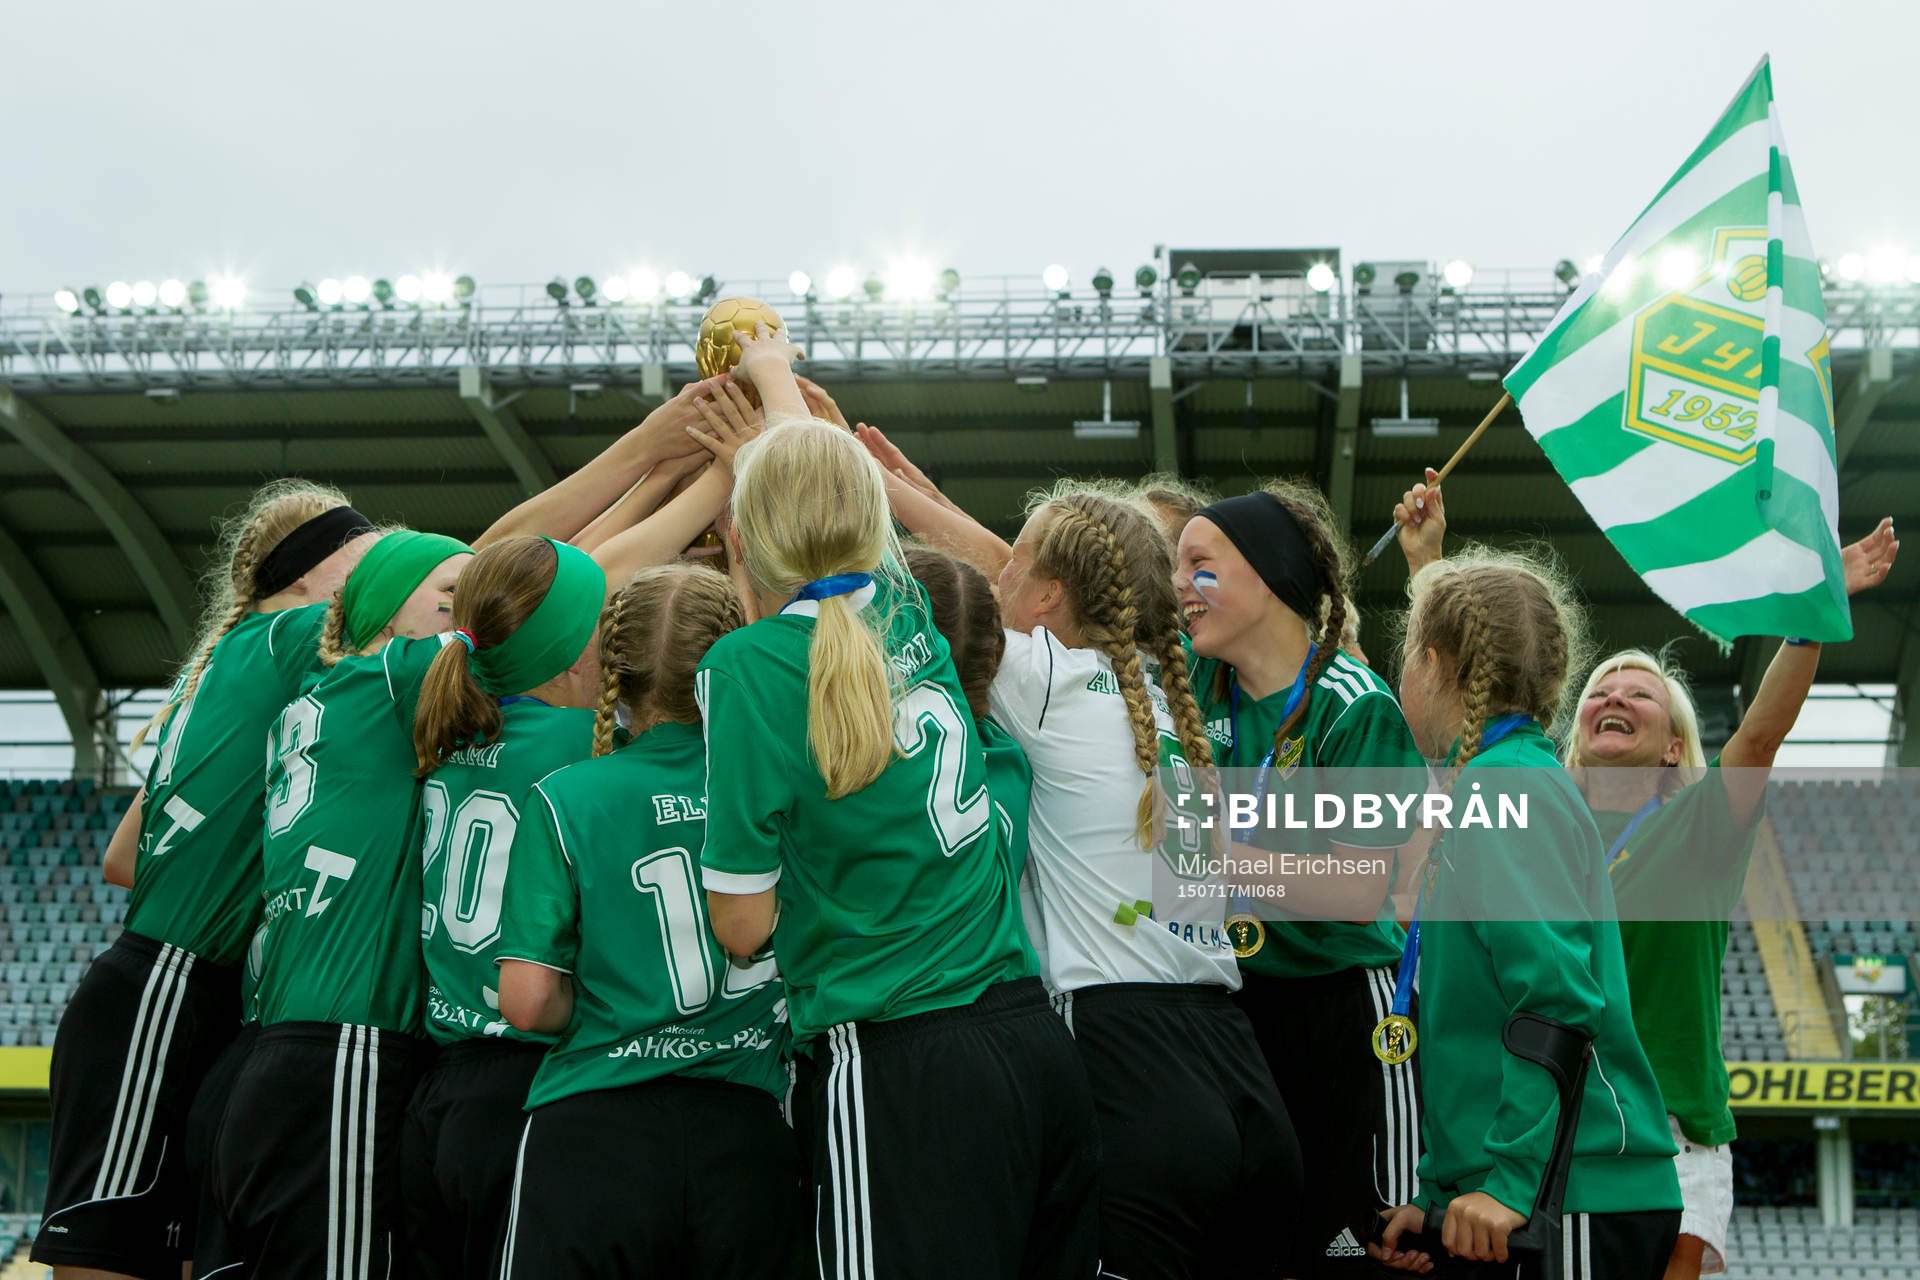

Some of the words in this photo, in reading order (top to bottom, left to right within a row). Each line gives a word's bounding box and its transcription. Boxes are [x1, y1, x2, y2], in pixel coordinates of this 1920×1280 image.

[1648, 388, 1759, 443] 1952
[652, 795, 708, 826] EL
[1729, 1068, 1920, 1103] OHLBER
[167, 1220, 182, 1249] 11
[1325, 1246, 1366, 1257] adidas
